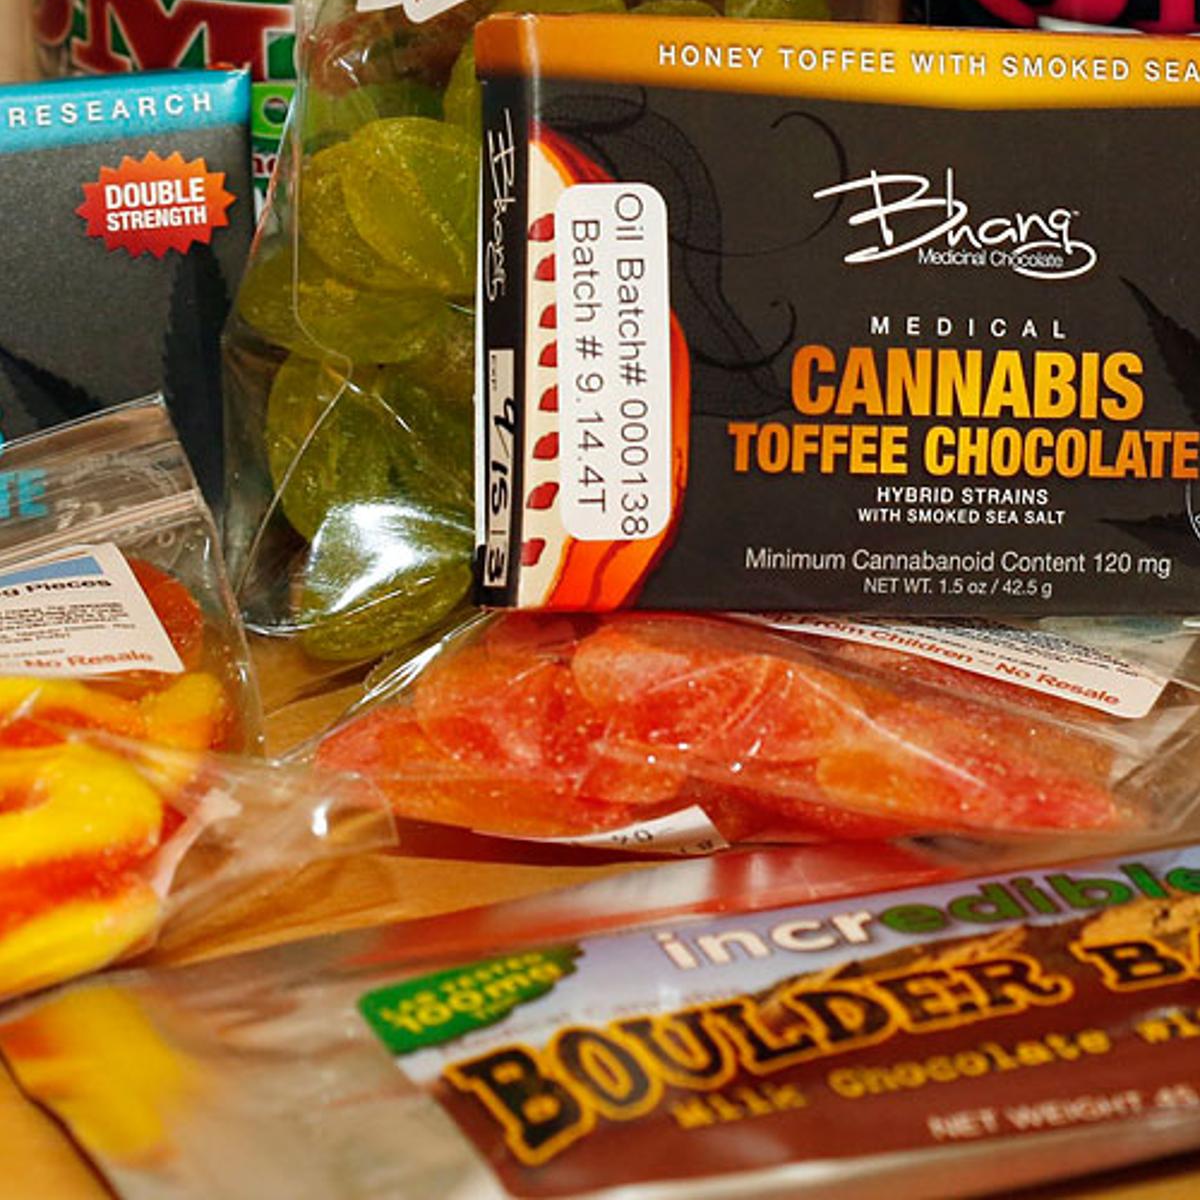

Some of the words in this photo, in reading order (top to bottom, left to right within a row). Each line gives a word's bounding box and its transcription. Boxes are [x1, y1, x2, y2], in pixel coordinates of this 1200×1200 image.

[657, 43, 765, 68] HONEY
[777, 47, 896, 74] TOFFEE
[910, 51, 987, 76] WITH
[1001, 55, 1131, 82] SMOKED
[7, 92, 213, 128] RESEARCH
[104, 177, 206, 210] DOUBLE
[105, 205, 208, 232] STRENGTH
[614, 192, 645, 242] Oil
[812, 167, 1098, 280] Bhang
[571, 218, 601, 323] Batch
[917, 249, 987, 267] Medicinal
[989, 249, 1065, 269] Chocolate
[615, 257, 650, 387] Batch#
[870, 316, 1068, 340] MEDICAL
[574, 335, 603, 361] #
[790, 343, 1145, 422] CANNABIS
[575, 375, 609, 514] 9.14.4T
[620, 399, 650, 537] 000138
[726, 421, 909, 475] TOFFEE
[856, 507, 902, 524] WITH
[905, 507, 981, 525] SMOKED
[984, 508, 1022, 525] SEA
[1023, 509, 1067, 526] SALT
[876, 485, 954, 506] HYBRID
[960, 487, 1049, 507] STRAINS
[744, 547, 847, 572] Minimum
[850, 549, 996, 573] Cannabanoid
[999, 550, 1087, 575] Content
[1092, 552, 1132, 576] 120
[1136, 557, 1172, 580] mg
[862, 577, 898, 596] NET
[900, 577, 934, 596] WT.
[938, 577, 960, 596] 1.5
[966, 583, 987, 596] oz
[1001, 578, 1038, 597] 42.5
[1040, 583, 1053, 599] g
[869, 626, 975, 664] Children
[994, 660, 1033, 679] No
[1035, 673, 1122, 706] Resale
[442, 950, 1075, 1167] BOULDER
[670, 1083, 806, 1130] Milk
[827, 1030, 1111, 1099] Chocolate
[927, 1105, 998, 1140] NET
[1005, 1089, 1144, 1129] WEIGHT
